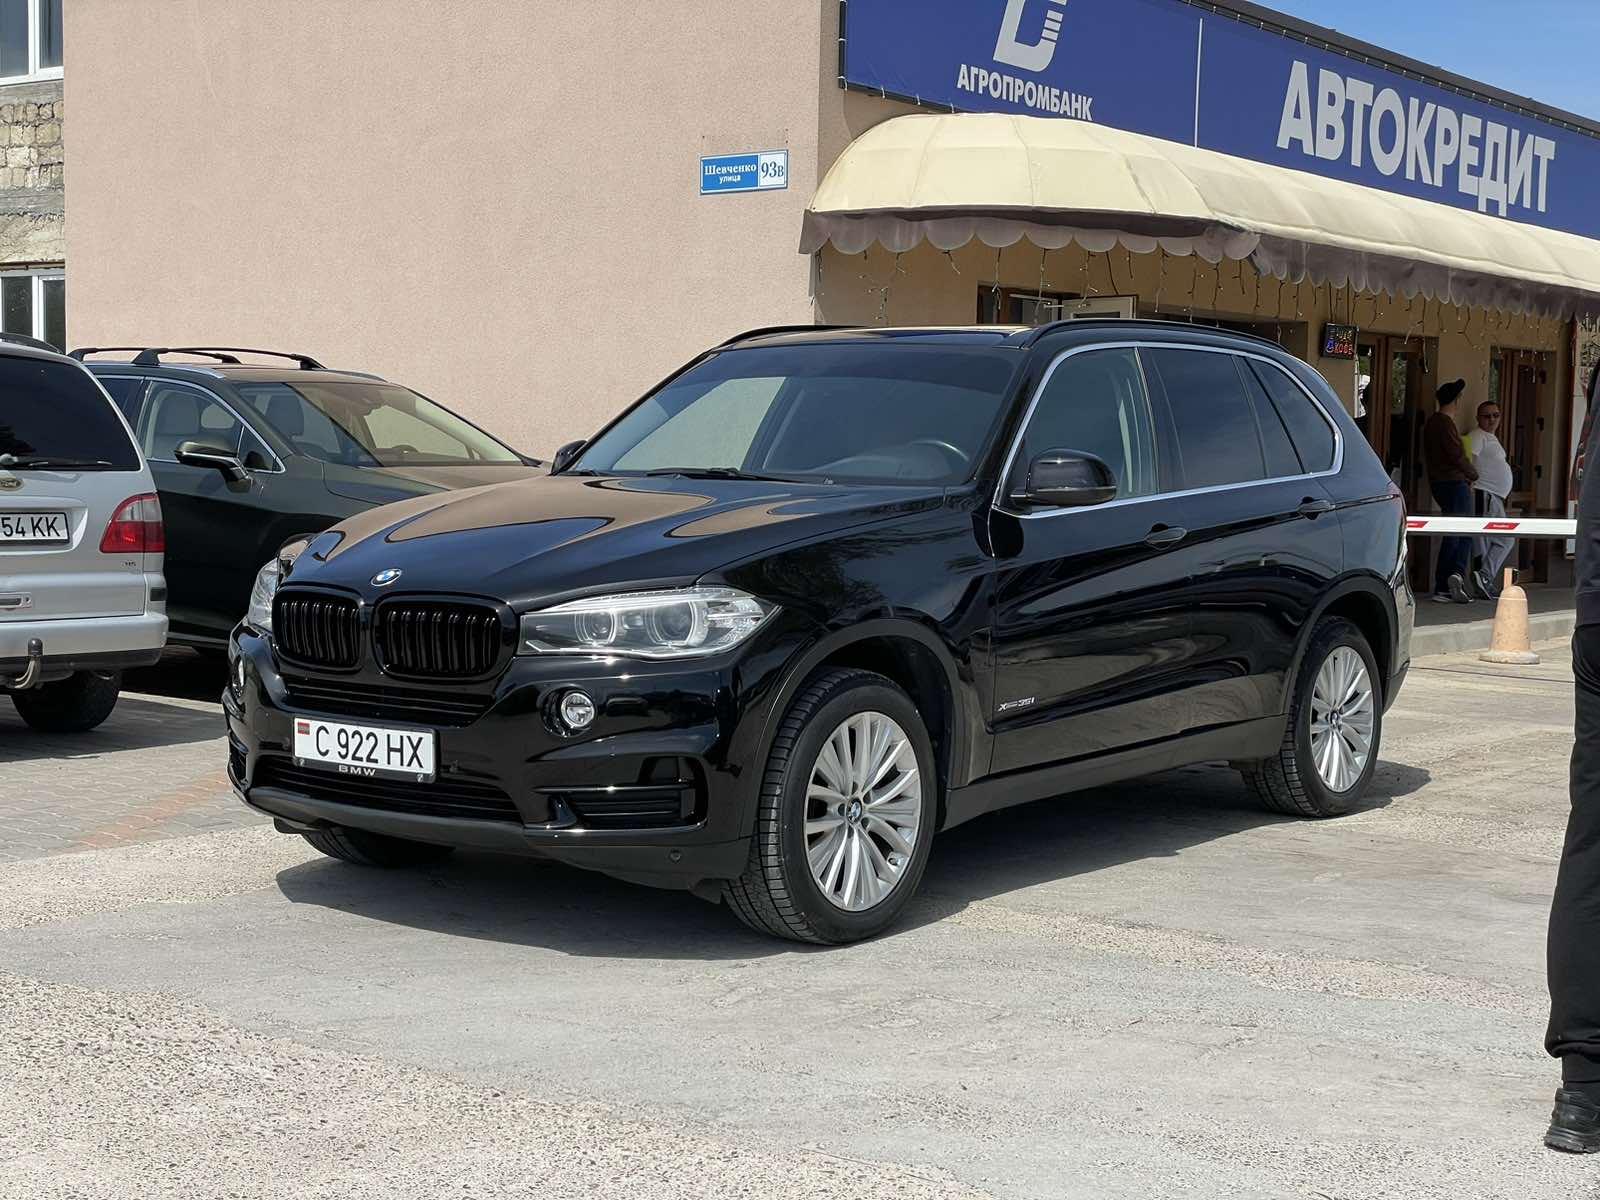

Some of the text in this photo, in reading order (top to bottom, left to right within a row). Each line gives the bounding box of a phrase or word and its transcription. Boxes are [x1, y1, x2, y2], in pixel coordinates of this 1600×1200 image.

[956, 63, 1094, 121] АГРОПРОМБАНК
[1276, 60, 1556, 217] АВТОКРЕДИТ
[704, 163, 757, 176] Шевченко
[719, 174, 741, 184] улица
[337, 728, 379, 764] 922
[338, 764, 376, 776] BMW
